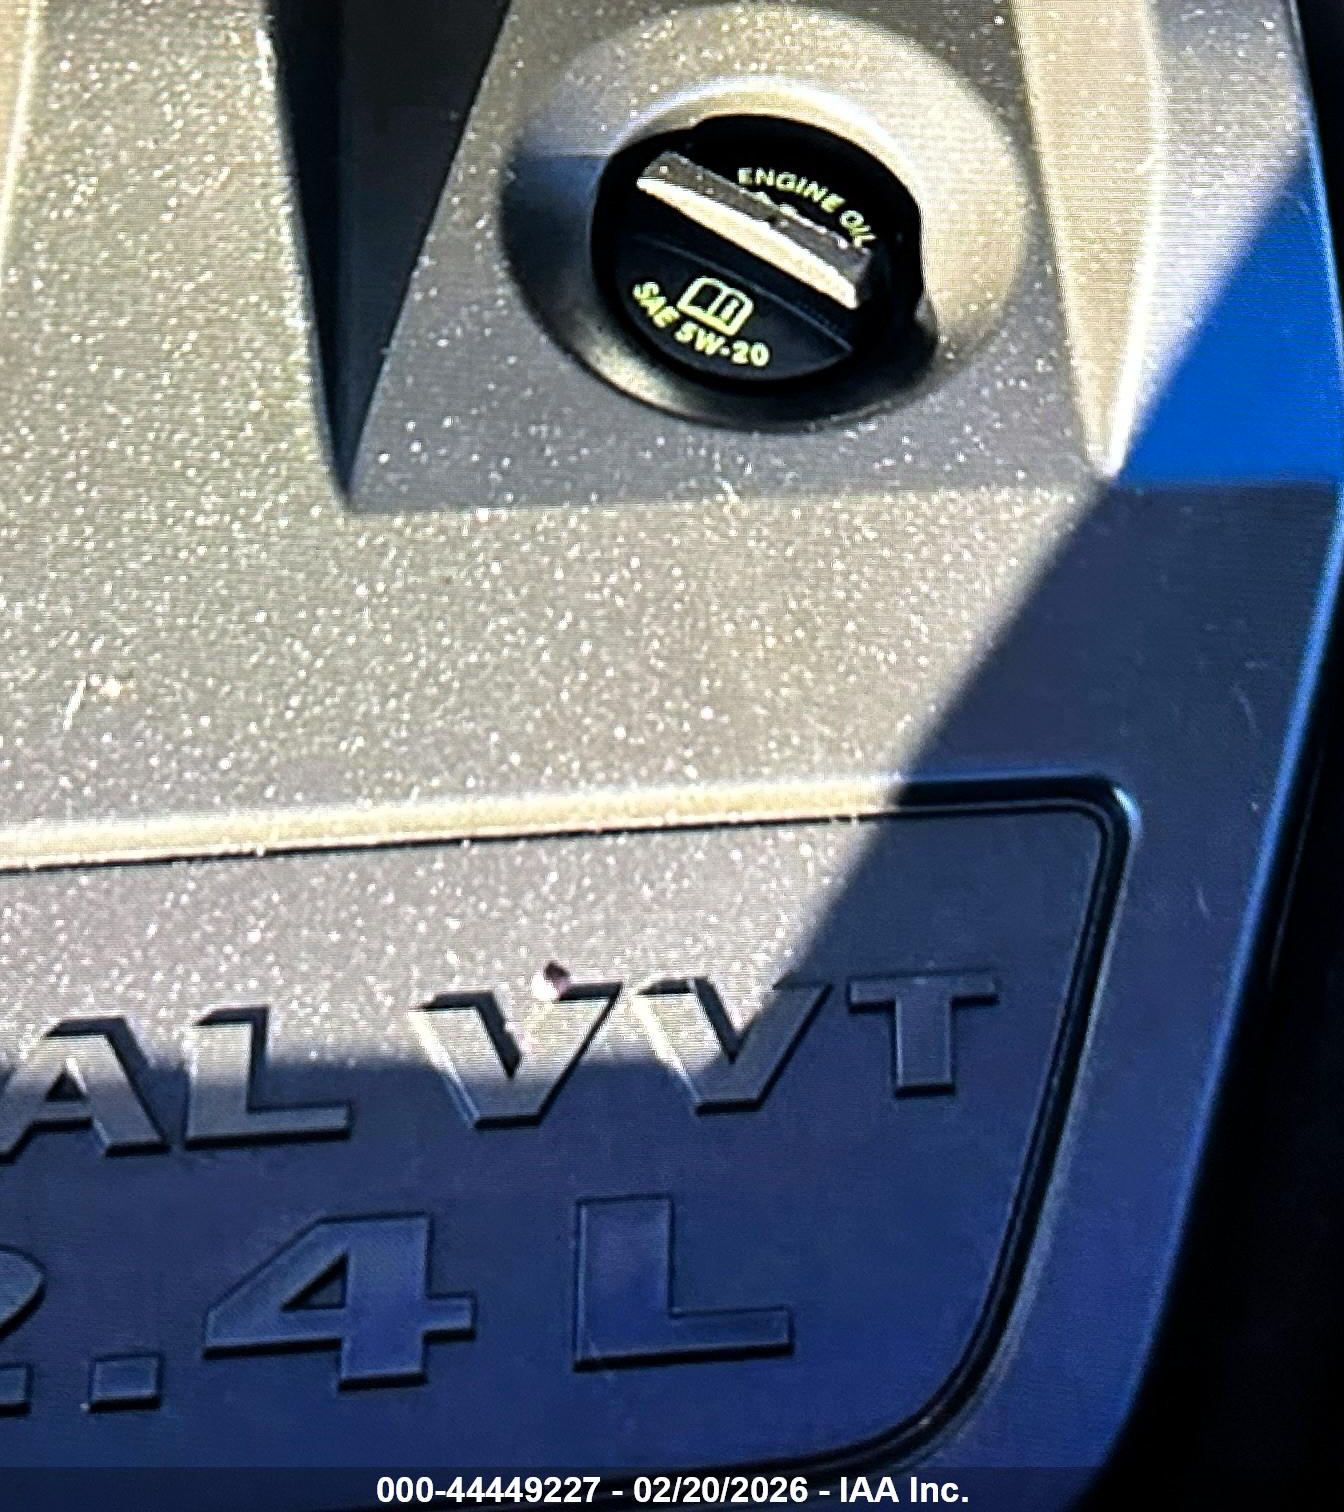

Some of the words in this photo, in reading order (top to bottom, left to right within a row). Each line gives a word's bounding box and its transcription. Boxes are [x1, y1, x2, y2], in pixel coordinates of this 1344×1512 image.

[737, 167, 846, 214] ENGINE
[840, 209, 877, 250] OIL
[631, 281, 676, 329] SAE
[674, 321, 770, 368] 5W-20
[411, 974, 1001, 1130] VVT
